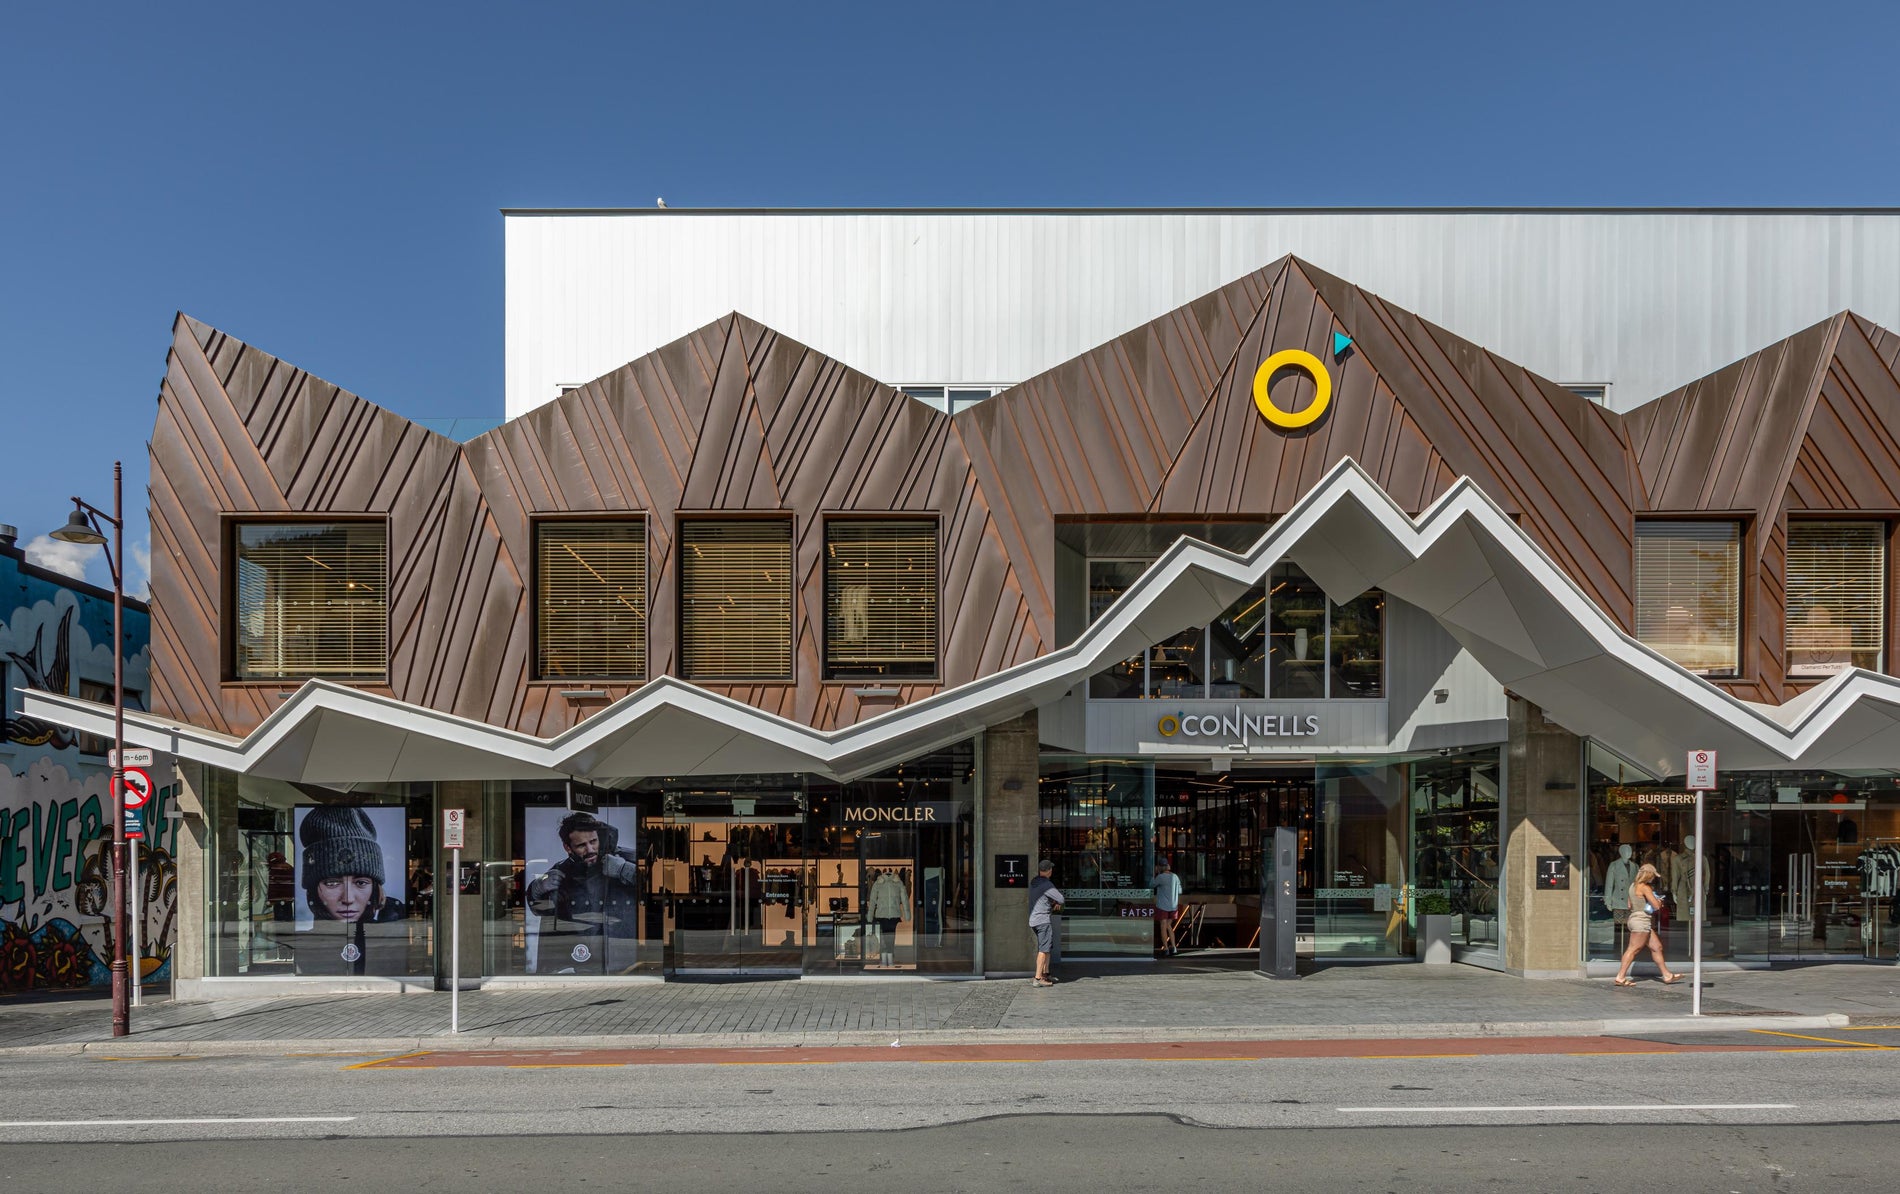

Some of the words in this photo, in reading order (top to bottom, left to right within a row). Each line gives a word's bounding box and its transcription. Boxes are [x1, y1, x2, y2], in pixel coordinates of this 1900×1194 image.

[1158, 704, 1320, 747] O'CONNELLS
[1638, 794, 1697, 804] BURBERRY
[845, 807, 936, 821] MONCLER
[1004, 860, 1019, 873] T
[1546, 860, 1561, 874] T
